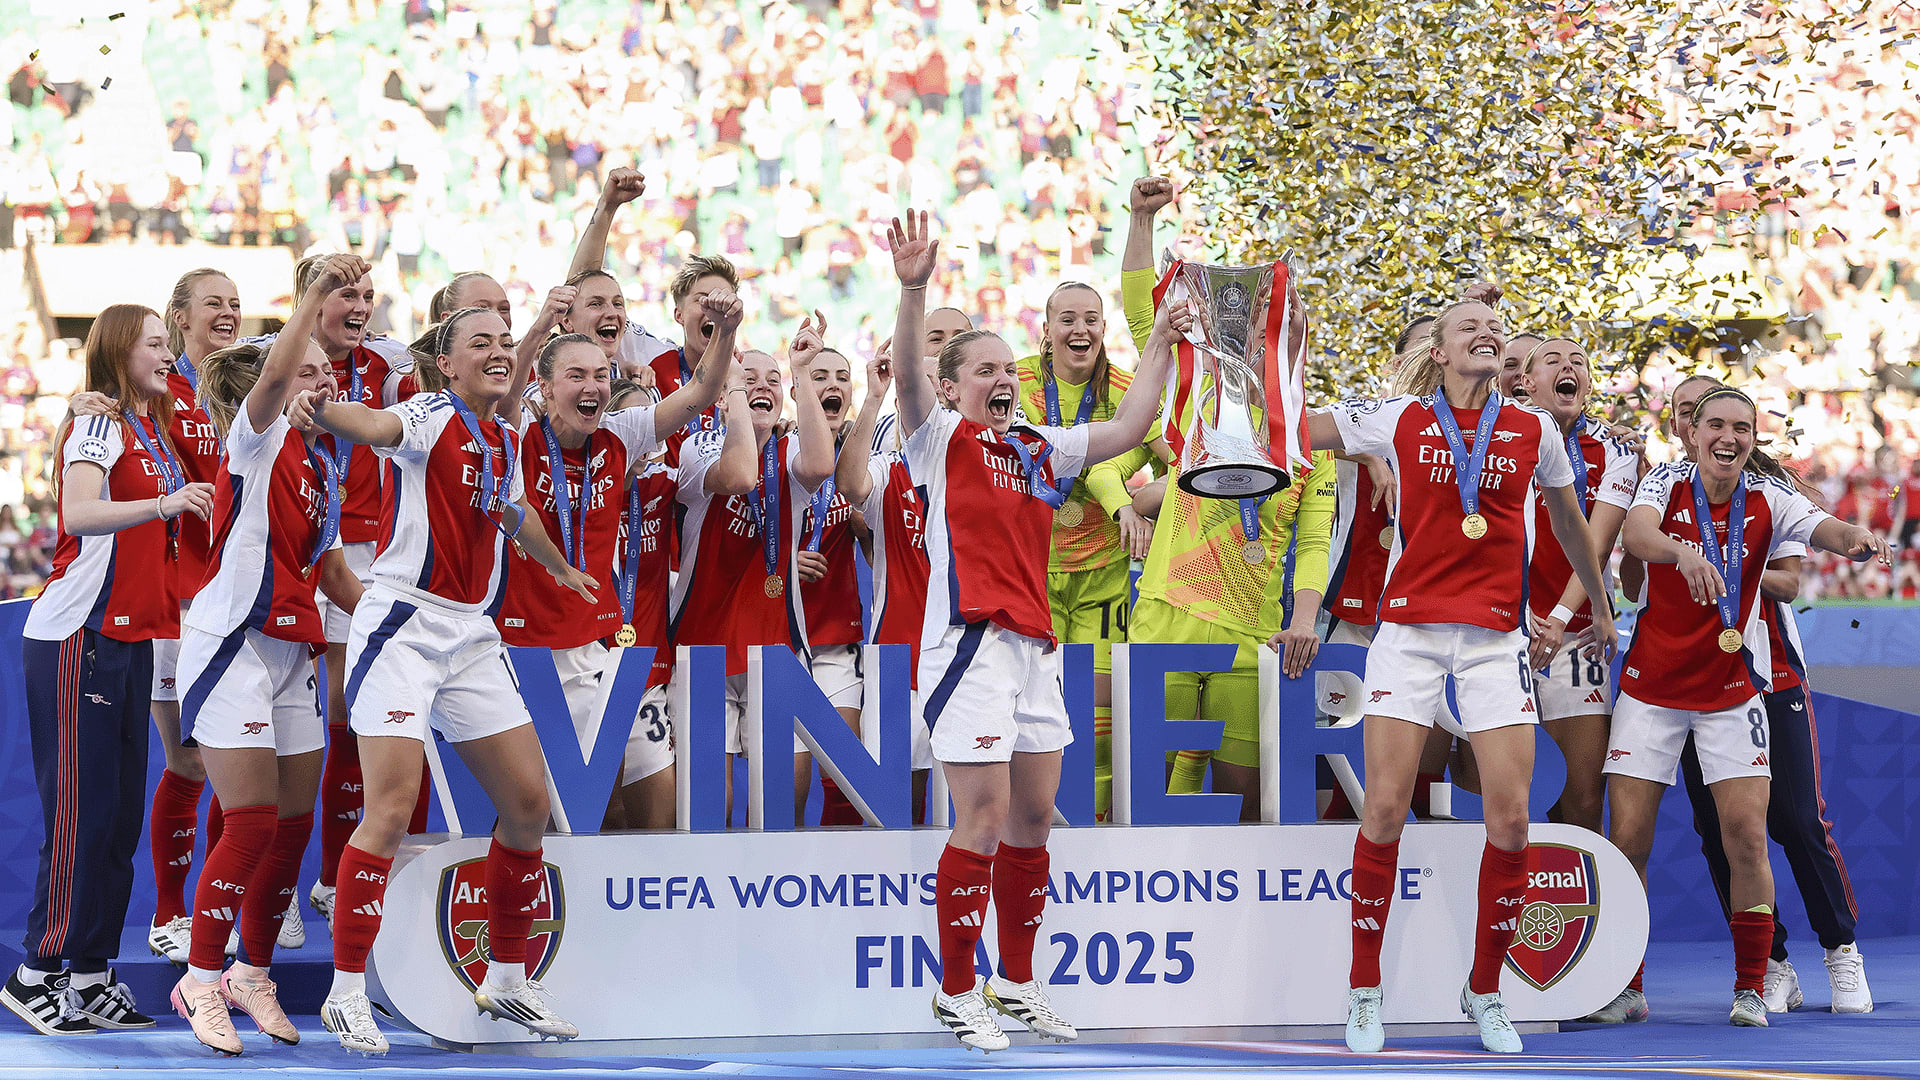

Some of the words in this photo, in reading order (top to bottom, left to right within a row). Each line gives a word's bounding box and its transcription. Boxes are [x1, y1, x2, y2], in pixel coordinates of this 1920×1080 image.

[198, 440, 215, 456] FLY
[1418, 444, 1518, 474] Emtes
[992, 472, 1008, 488] FLY
[1430, 466, 1452, 484] FLY
[821, 504, 853, 528] ETTER
[728, 517, 745, 537] FLY
[1702, 522, 1712, 540] LISBON
[1517, 650, 1532, 694] 6
[1567, 646, 1604, 687] 18
[640, 704, 671, 743] 3
[1747, 708, 1766, 748] 8
[341, 782, 364, 793] AF
[355, 870, 386, 886] AFC
[522, 868, 544, 882] AF
[1527, 866, 1583, 889] senal
[210, 879, 246, 895] AFC
[279, 886, 296, 896] AF
[453, 881, 548, 904] Arsl
[605, 876, 716, 911] UEFA
[728, 872, 936, 908] WOMEN'S
[1046, 868, 1240, 904] AMPIONS
[952, 885, 988, 896] AFC
[1029, 884, 1050, 898] AF
[1352, 891, 1384, 906] AFC
[1496, 894, 1526, 906] AFC
[856, 936, 994, 988] FIN
[1049, 932, 1196, 986] 2025
[342, 1034, 376, 1046] F50
